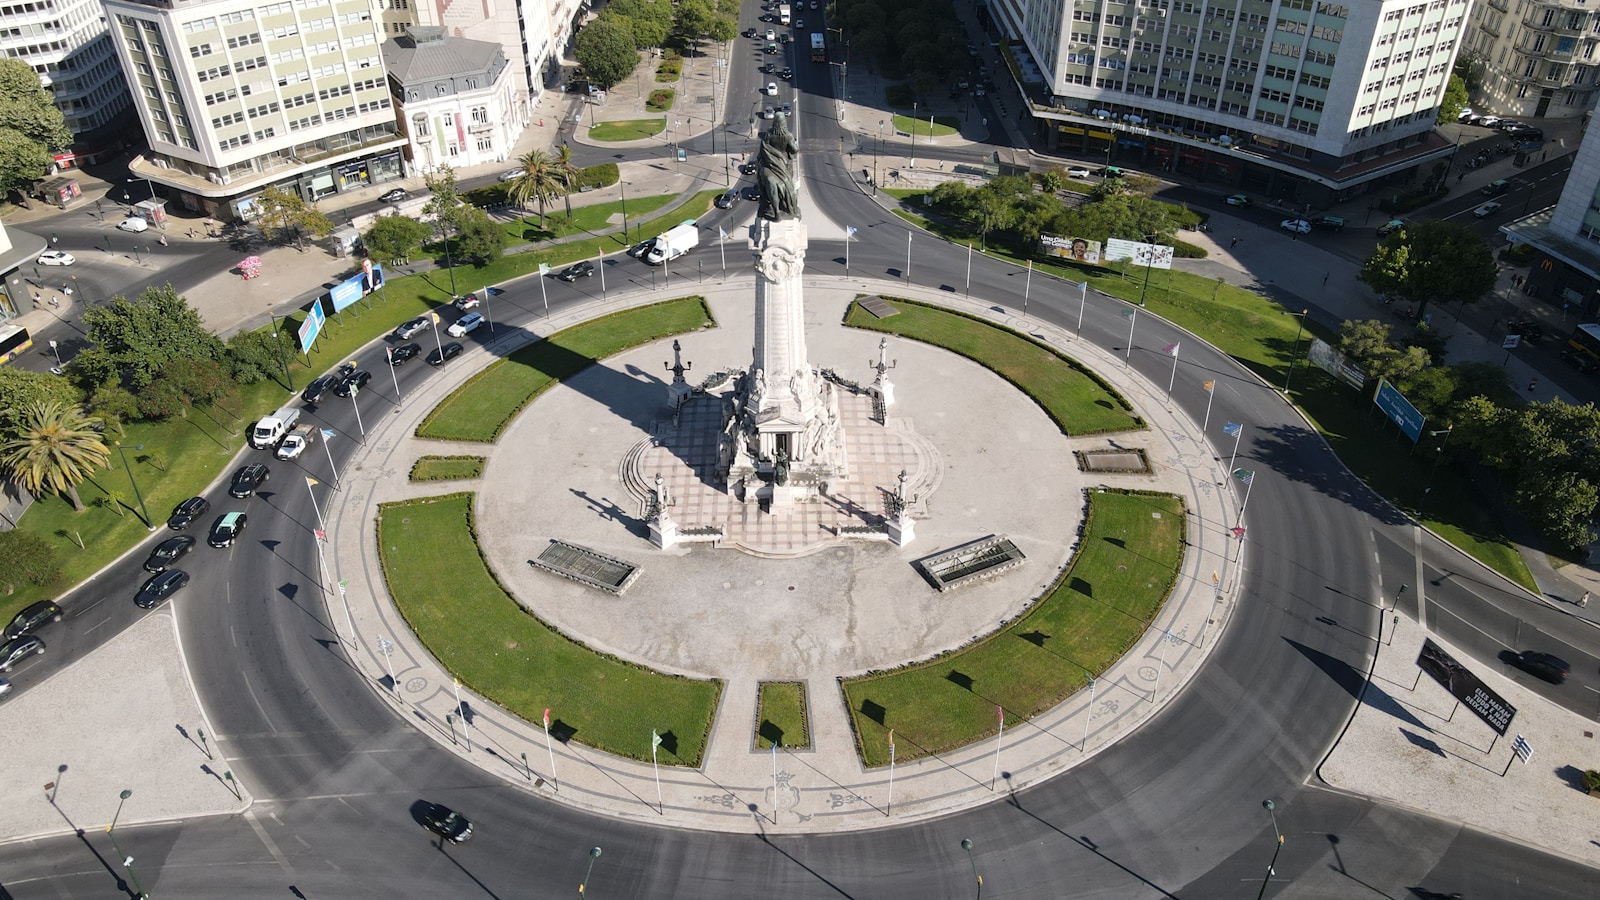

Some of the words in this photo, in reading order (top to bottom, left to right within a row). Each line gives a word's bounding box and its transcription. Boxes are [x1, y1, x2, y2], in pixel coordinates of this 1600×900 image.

[1465, 695, 1488, 716] DEIXAM
[1487, 715, 1505, 730] NADA
[1473, 694, 1490, 709] TUDO
[1494, 711, 1508, 725] NÃO
[1475, 688, 1489, 701] ELES
[1489, 699, 1511, 719] MATAM
